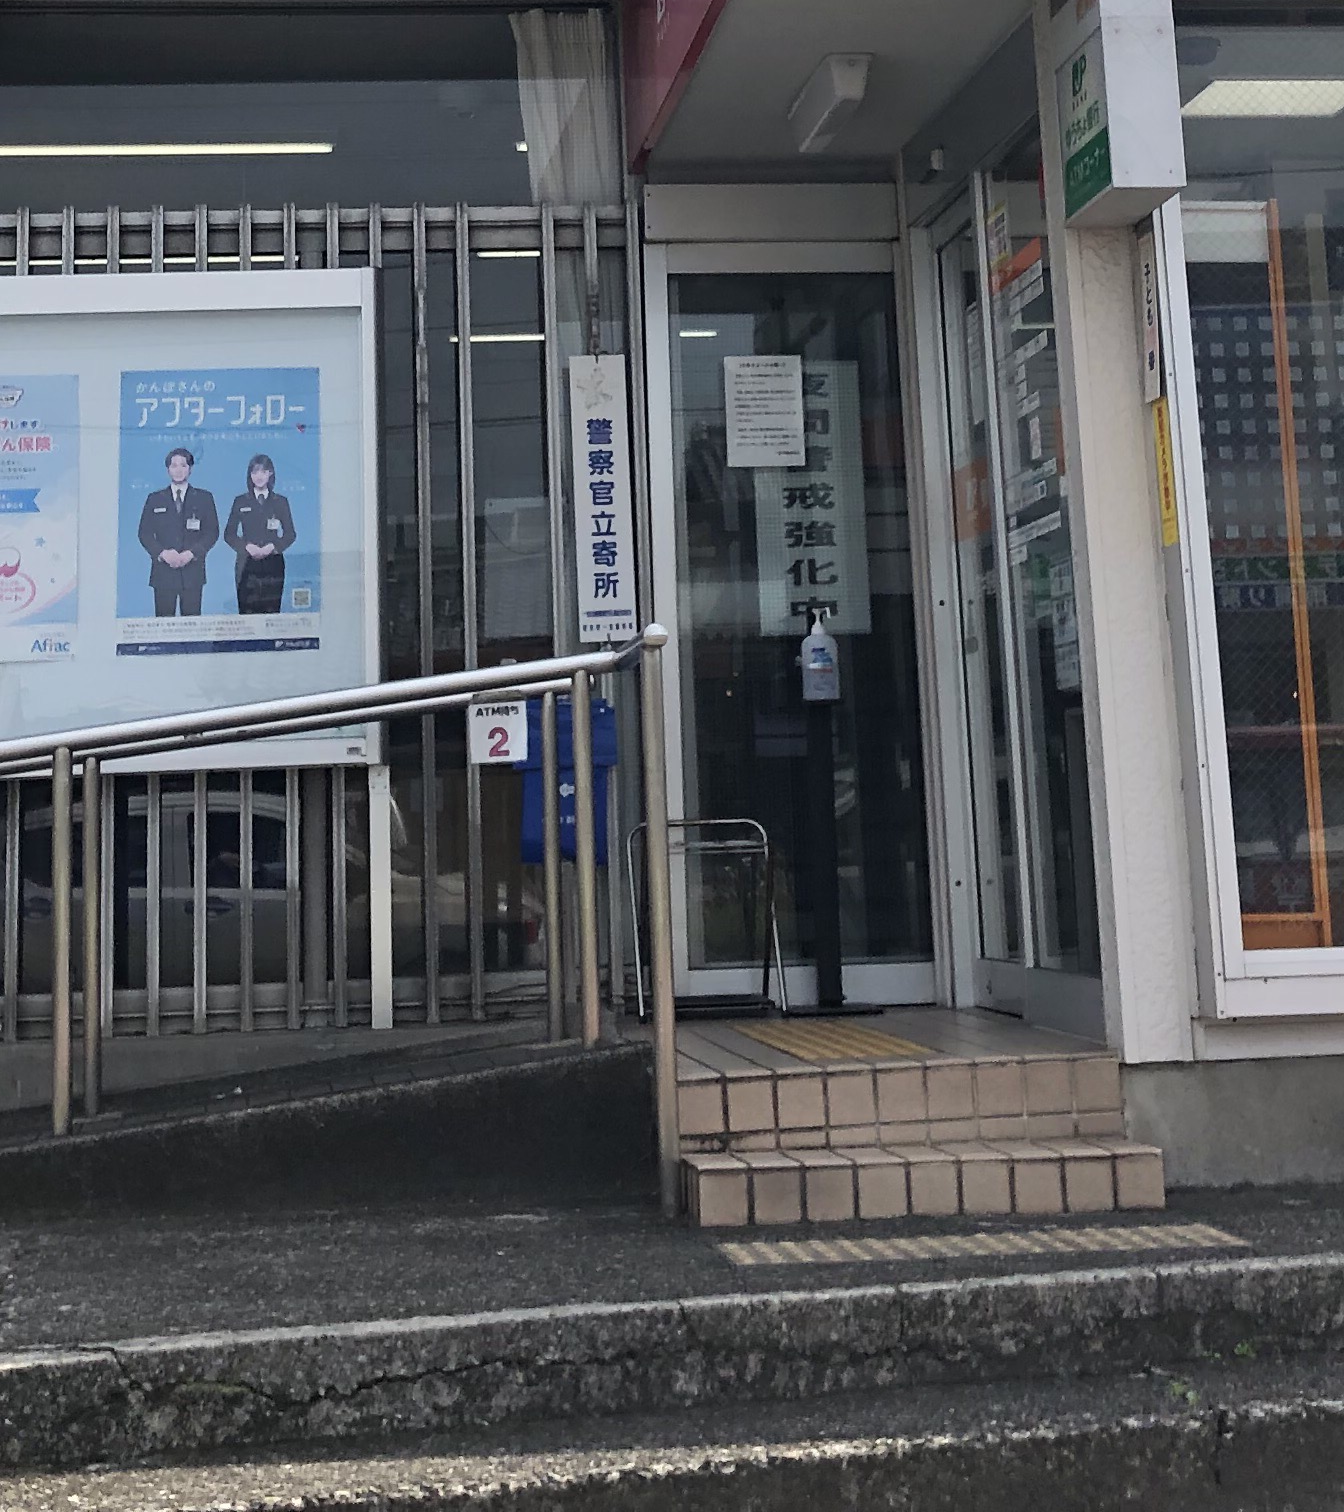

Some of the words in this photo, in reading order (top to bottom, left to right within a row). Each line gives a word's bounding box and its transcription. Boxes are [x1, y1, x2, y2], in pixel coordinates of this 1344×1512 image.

[135, 394, 305, 428] アフターフォロー
[586, 418, 620, 599] 警察官立寄所
[487, 726, 511, 758] 2
